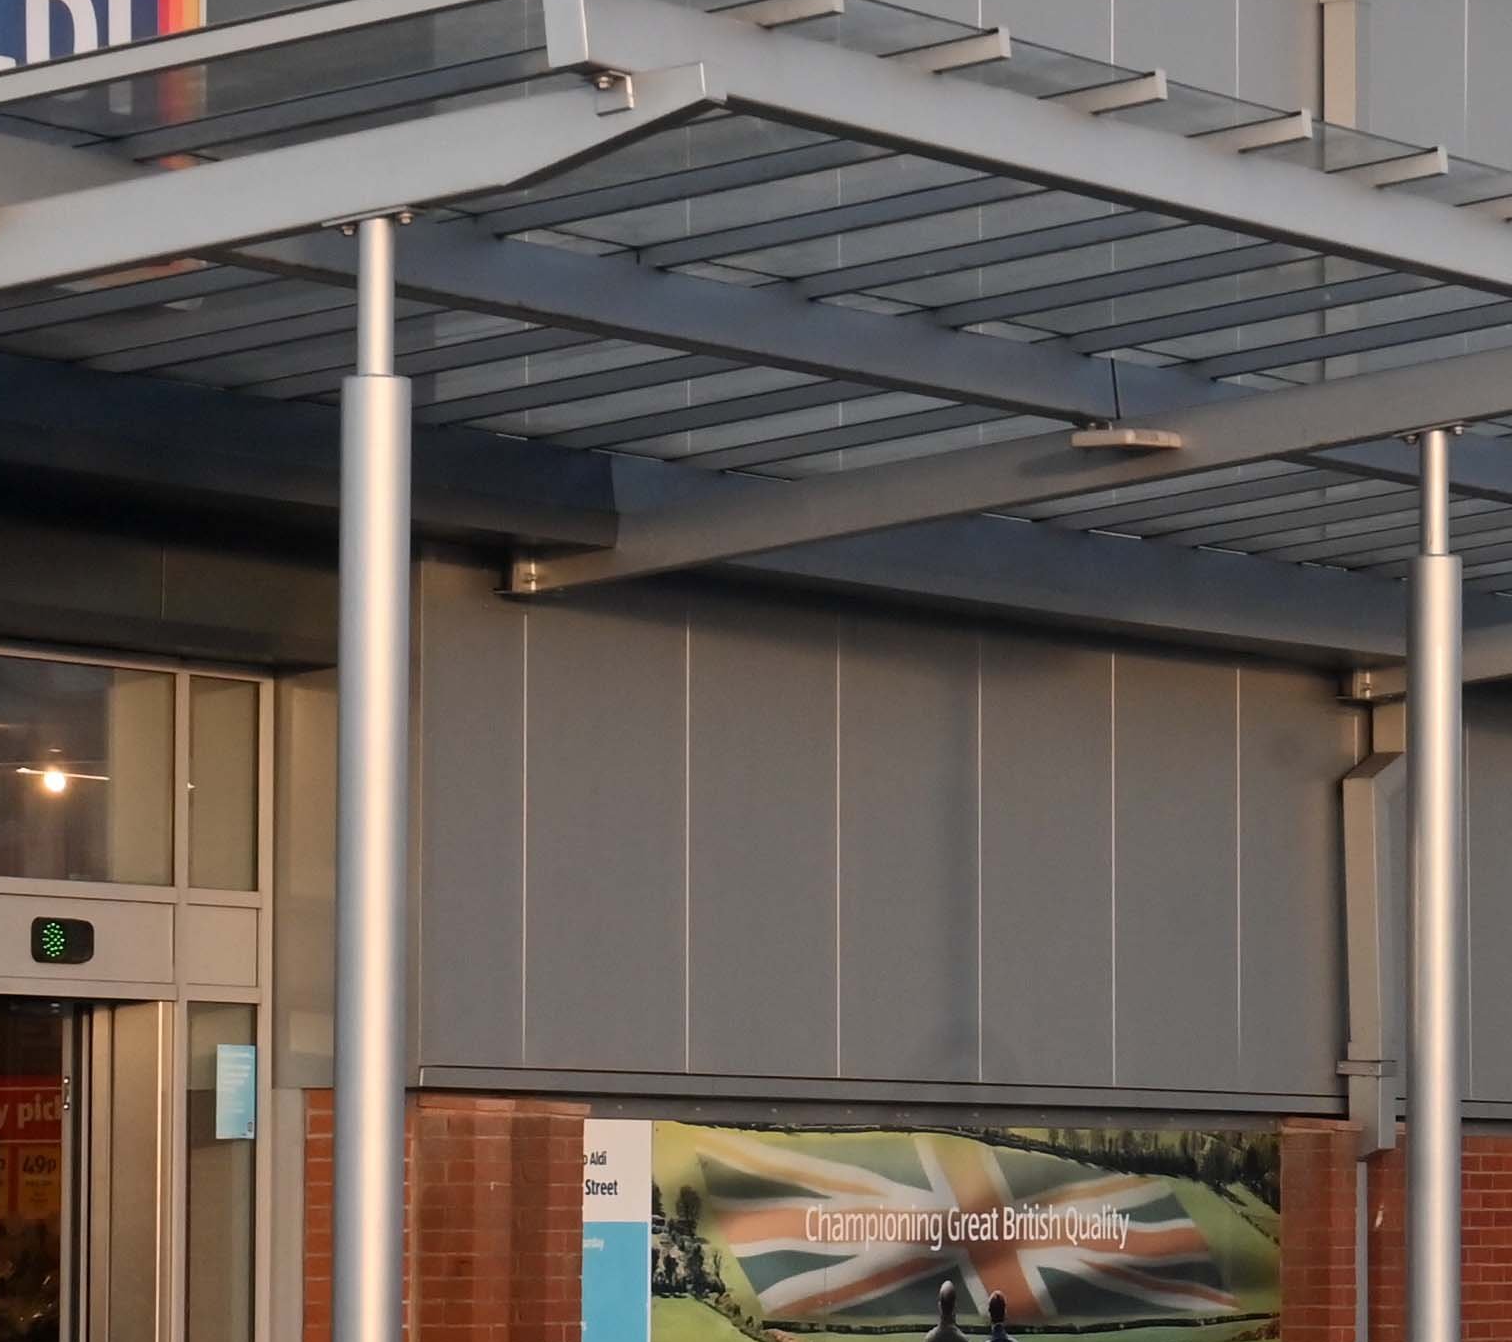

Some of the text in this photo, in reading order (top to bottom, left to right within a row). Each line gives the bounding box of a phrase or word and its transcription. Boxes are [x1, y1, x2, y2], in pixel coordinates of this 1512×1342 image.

[590, 1150, 607, 1166] Aldi
[585, 1179, 618, 1196] Street
[805, 1203, 1131, 1251] Championing Great British Quality
